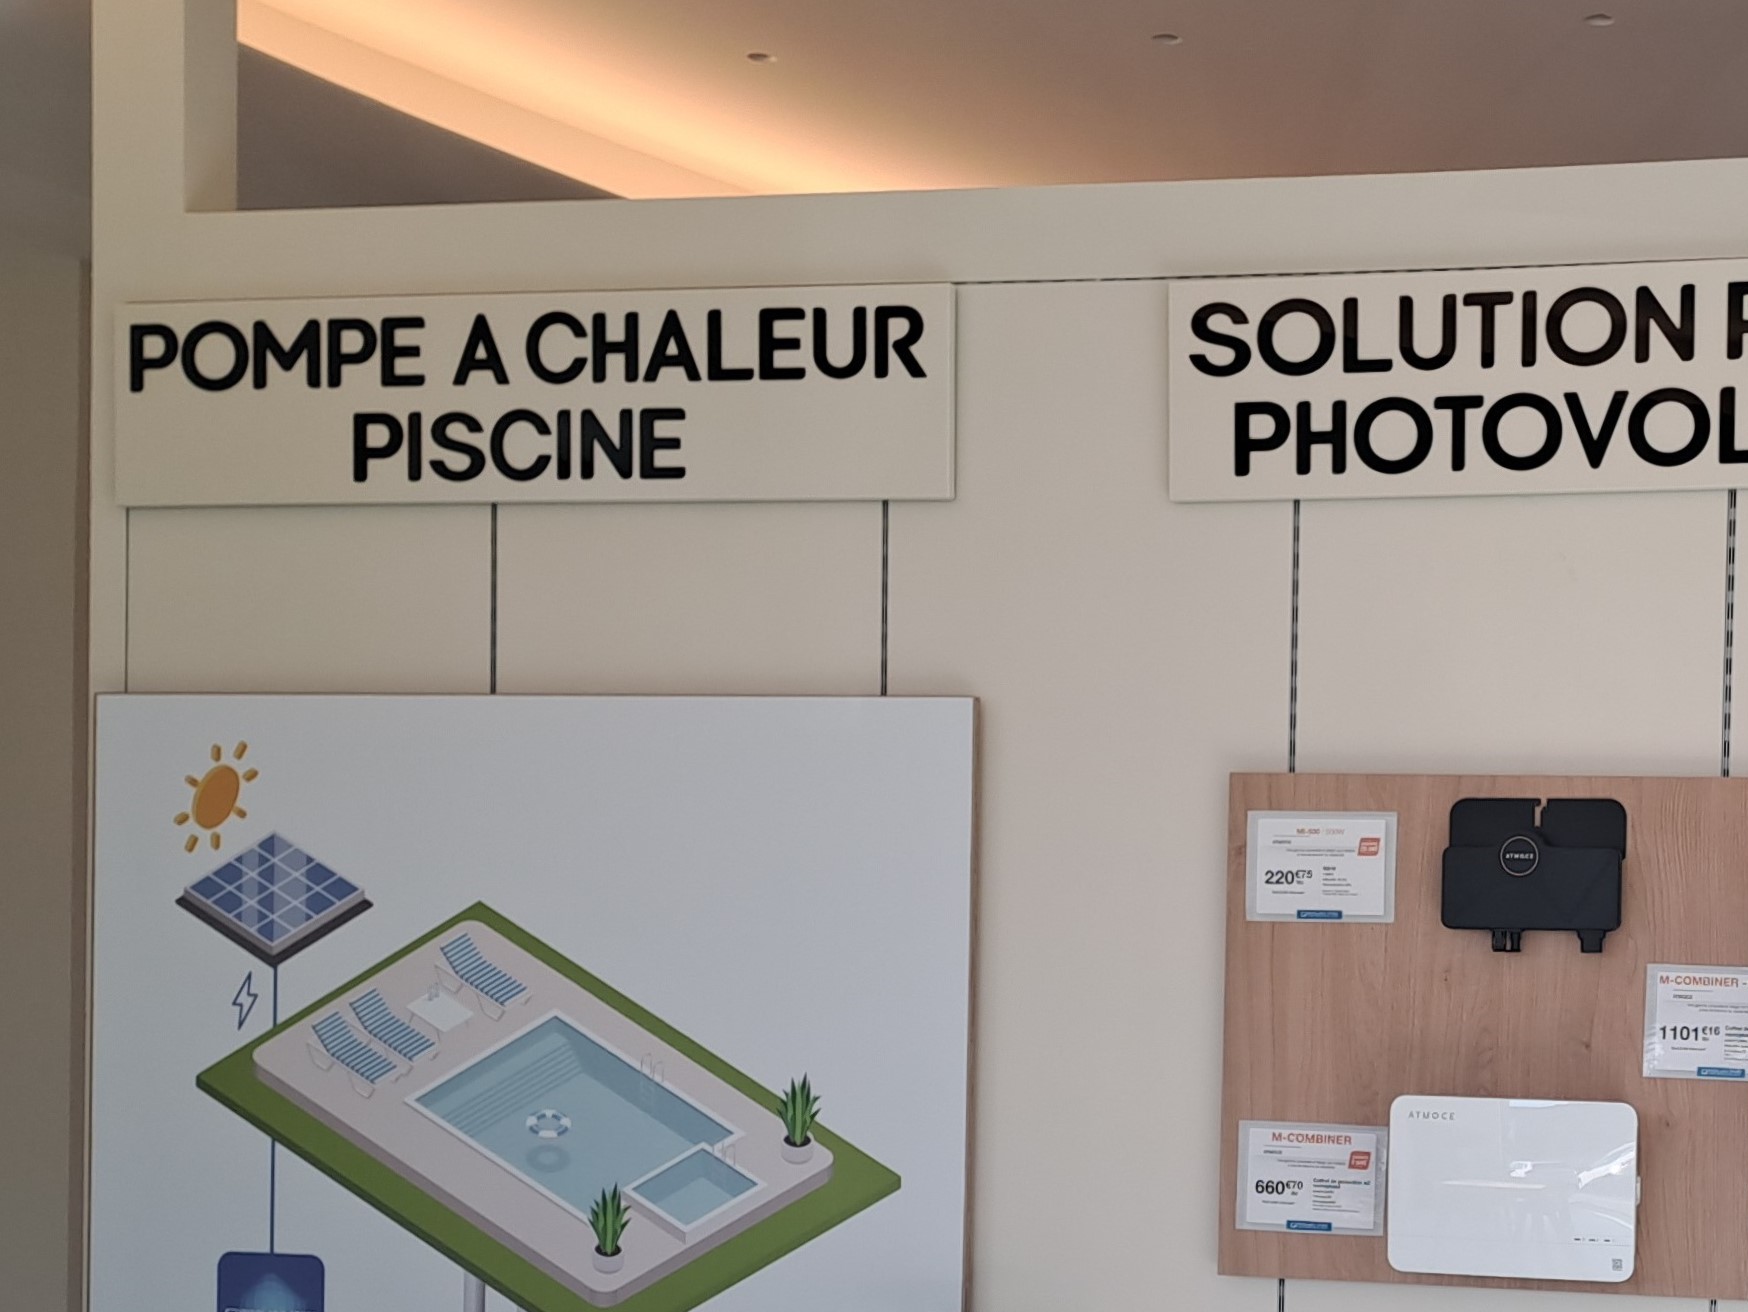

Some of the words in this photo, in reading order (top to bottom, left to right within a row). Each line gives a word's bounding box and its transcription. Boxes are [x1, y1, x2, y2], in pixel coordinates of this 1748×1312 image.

[128, 315, 426, 393] POMPE
[452, 313, 509, 386] A
[526, 304, 928, 385] CHALEUR
[1187, 283, 1696, 378] SOLUTION
[352, 407, 687, 483] PISCINE
[1659, 975, 1739, 988] M-COMBINER
[1408, 1111, 1455, 1120] ATMOCE
[1272, 1132, 1352, 1145] M-COMBINER
